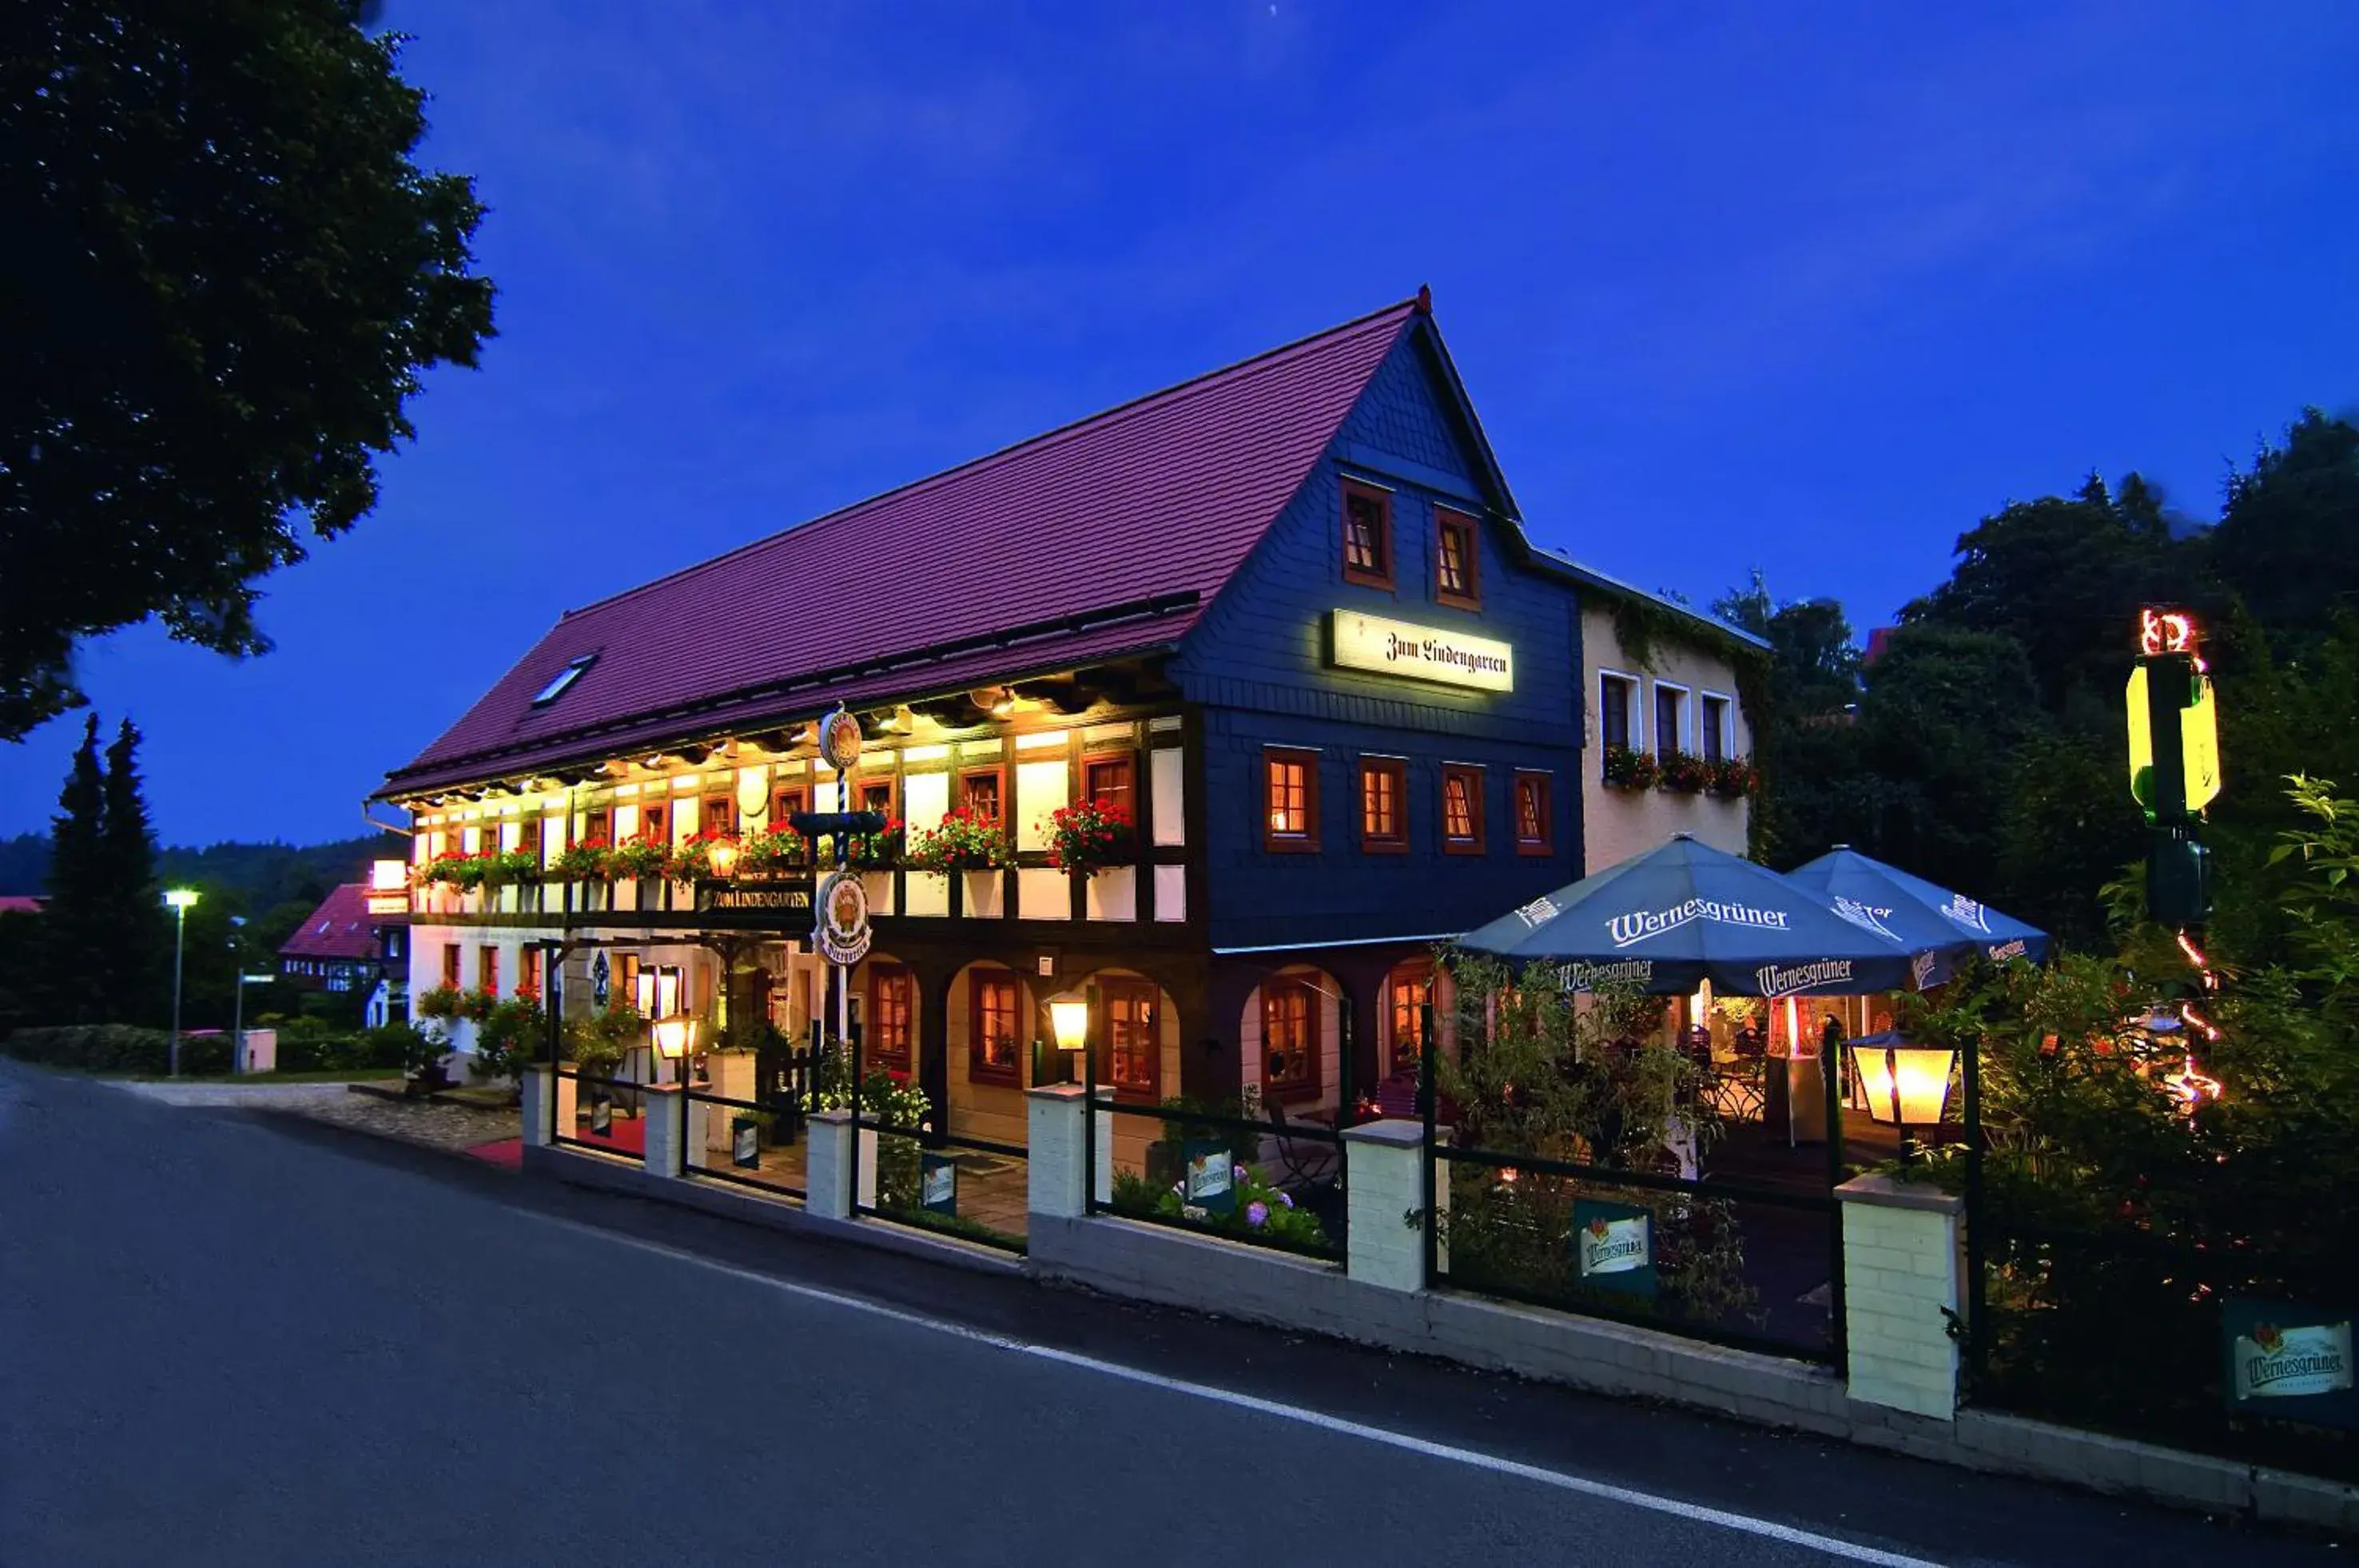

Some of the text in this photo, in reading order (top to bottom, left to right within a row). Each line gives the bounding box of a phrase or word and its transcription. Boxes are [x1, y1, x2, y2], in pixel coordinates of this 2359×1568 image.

[1386, 631, 1506, 674] Zum Lindengarten
[735, 889, 809, 908] LINDENGARTEN
[1605, 897, 1788, 942] Wernesgrüner
[1756, 957, 1852, 997] Wernesgrüner
[2246, 1353, 2342, 1384] Wernesgrüner
